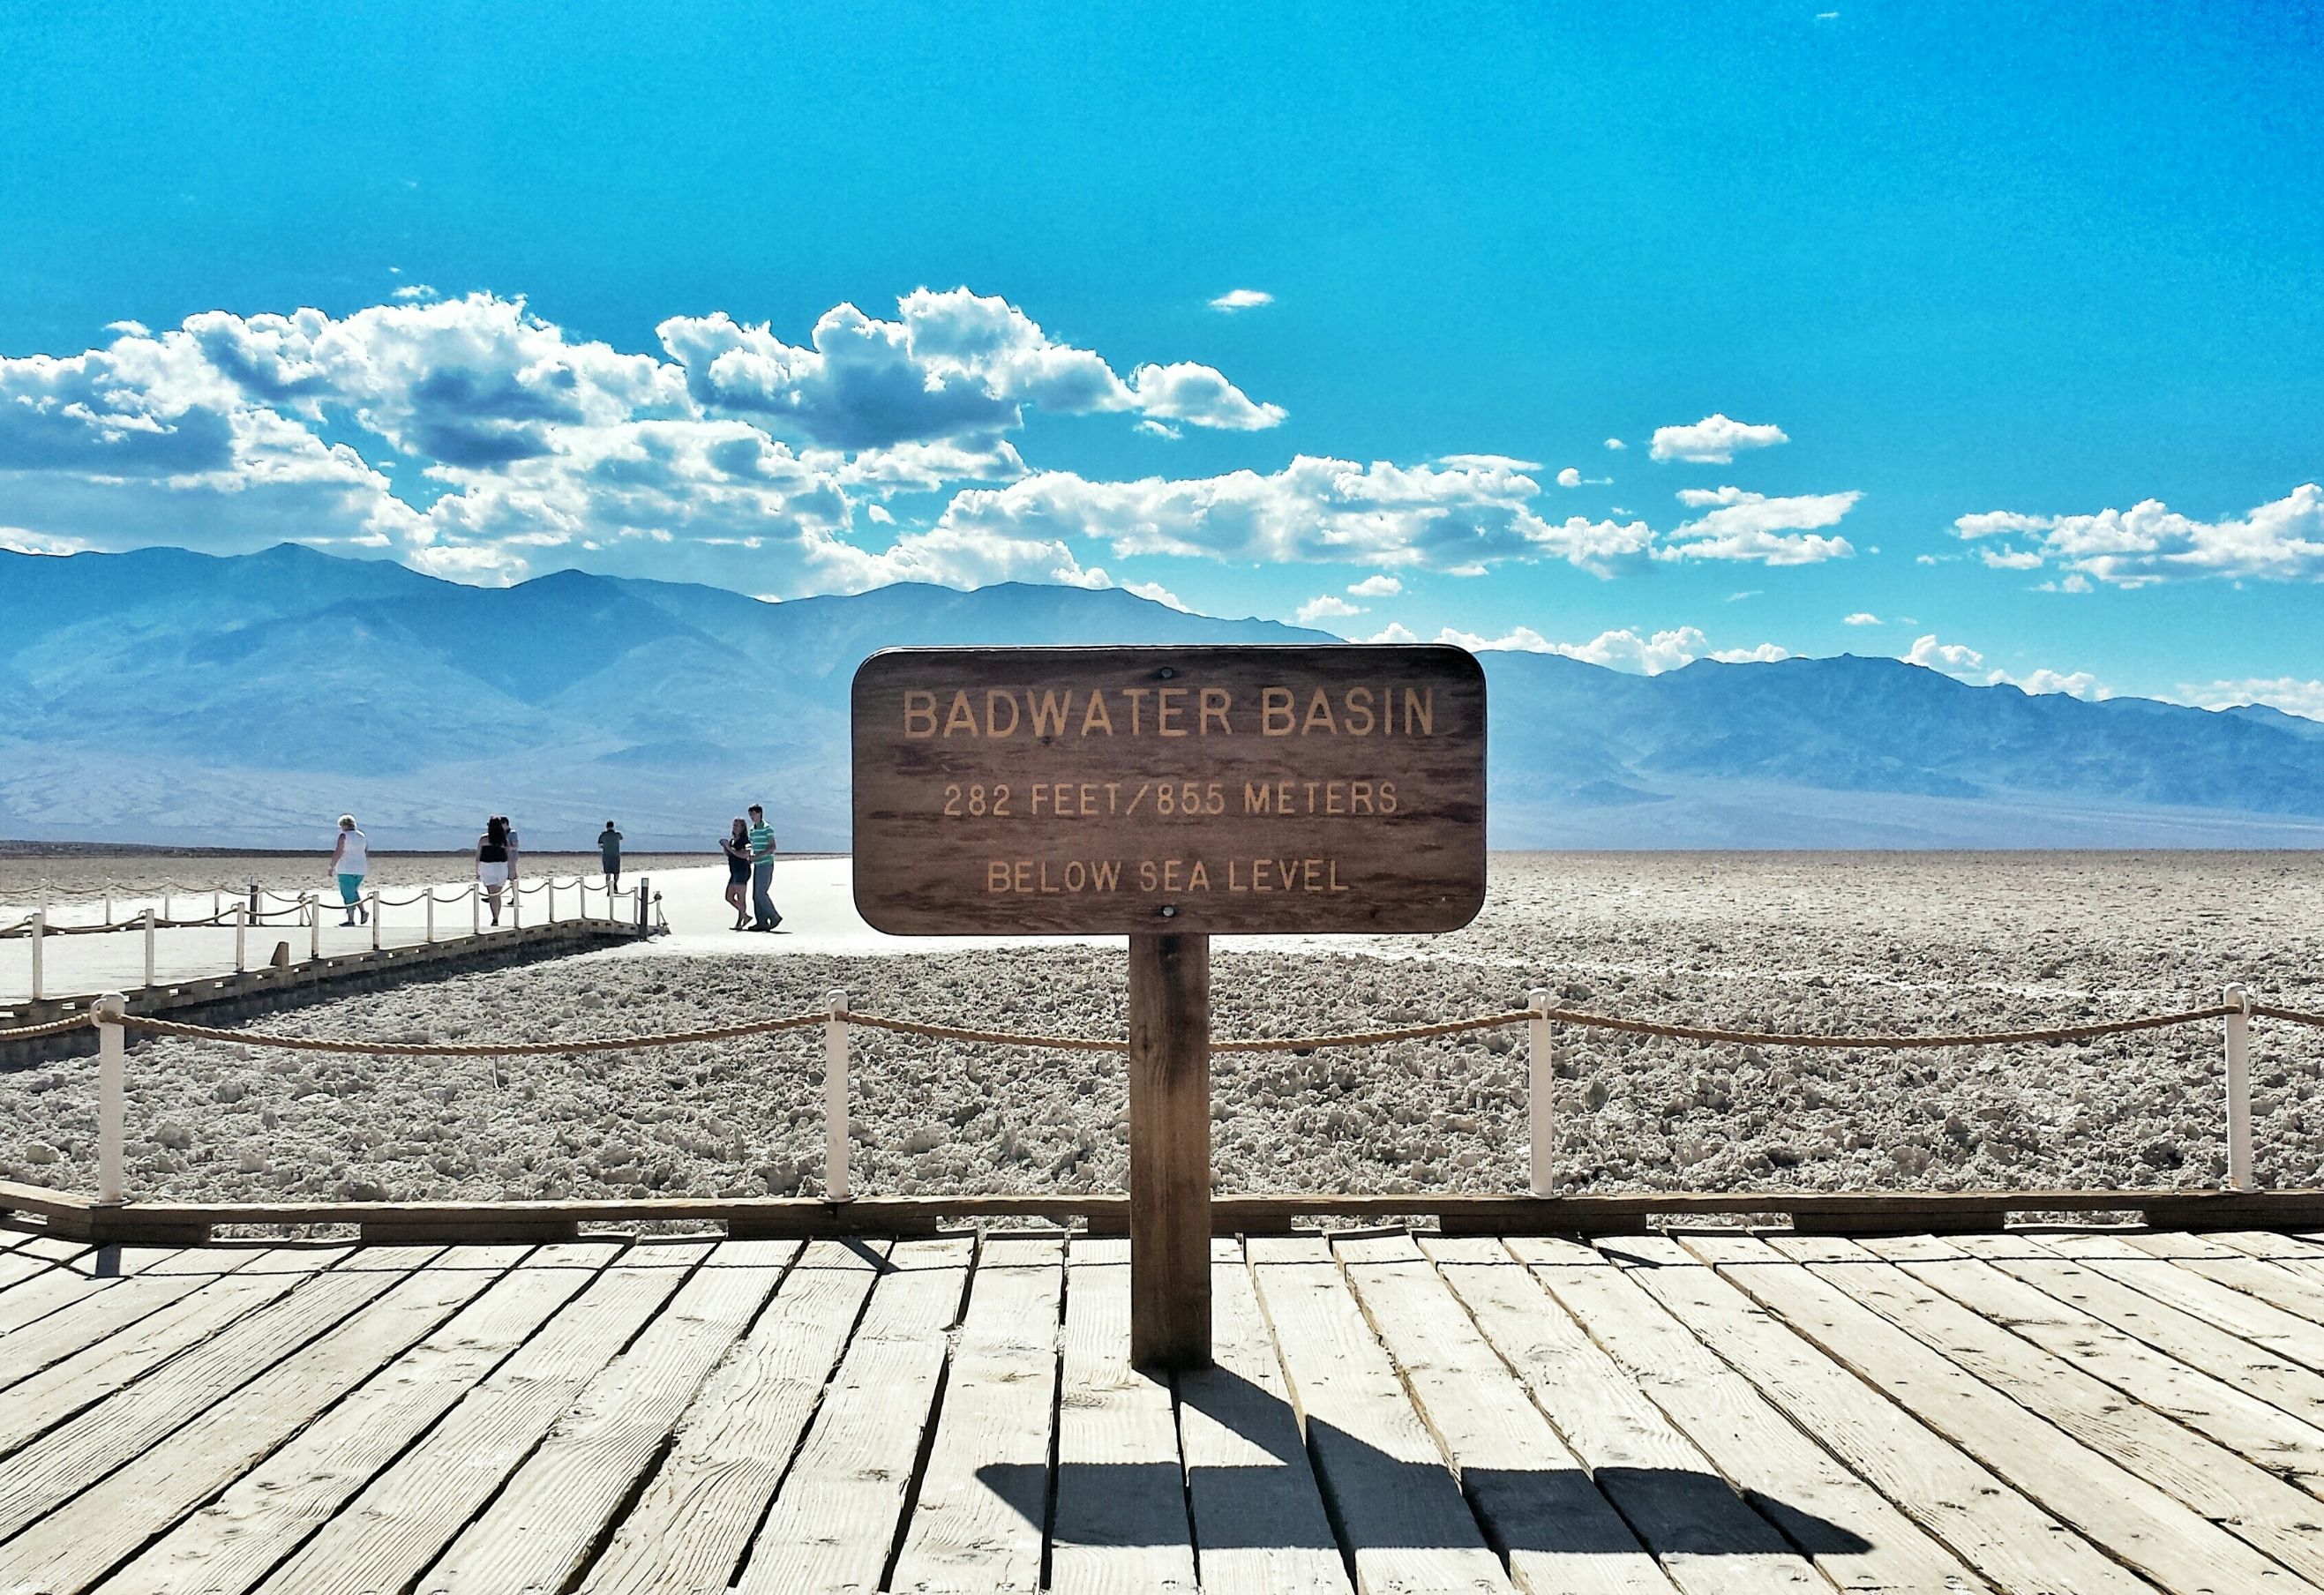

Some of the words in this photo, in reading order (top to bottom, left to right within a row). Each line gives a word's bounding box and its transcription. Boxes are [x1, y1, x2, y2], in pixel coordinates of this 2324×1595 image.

[903, 688, 1233, 738] BADWATER
[1262, 686, 1435, 737] BASIN
[943, 783, 1010, 816] 282
[1244, 783, 1398, 814] METERS
[987, 860, 1121, 893] BELOW
[1139, 860, 1211, 892] SEA
[1228, 860, 1349, 892] LEVEL
